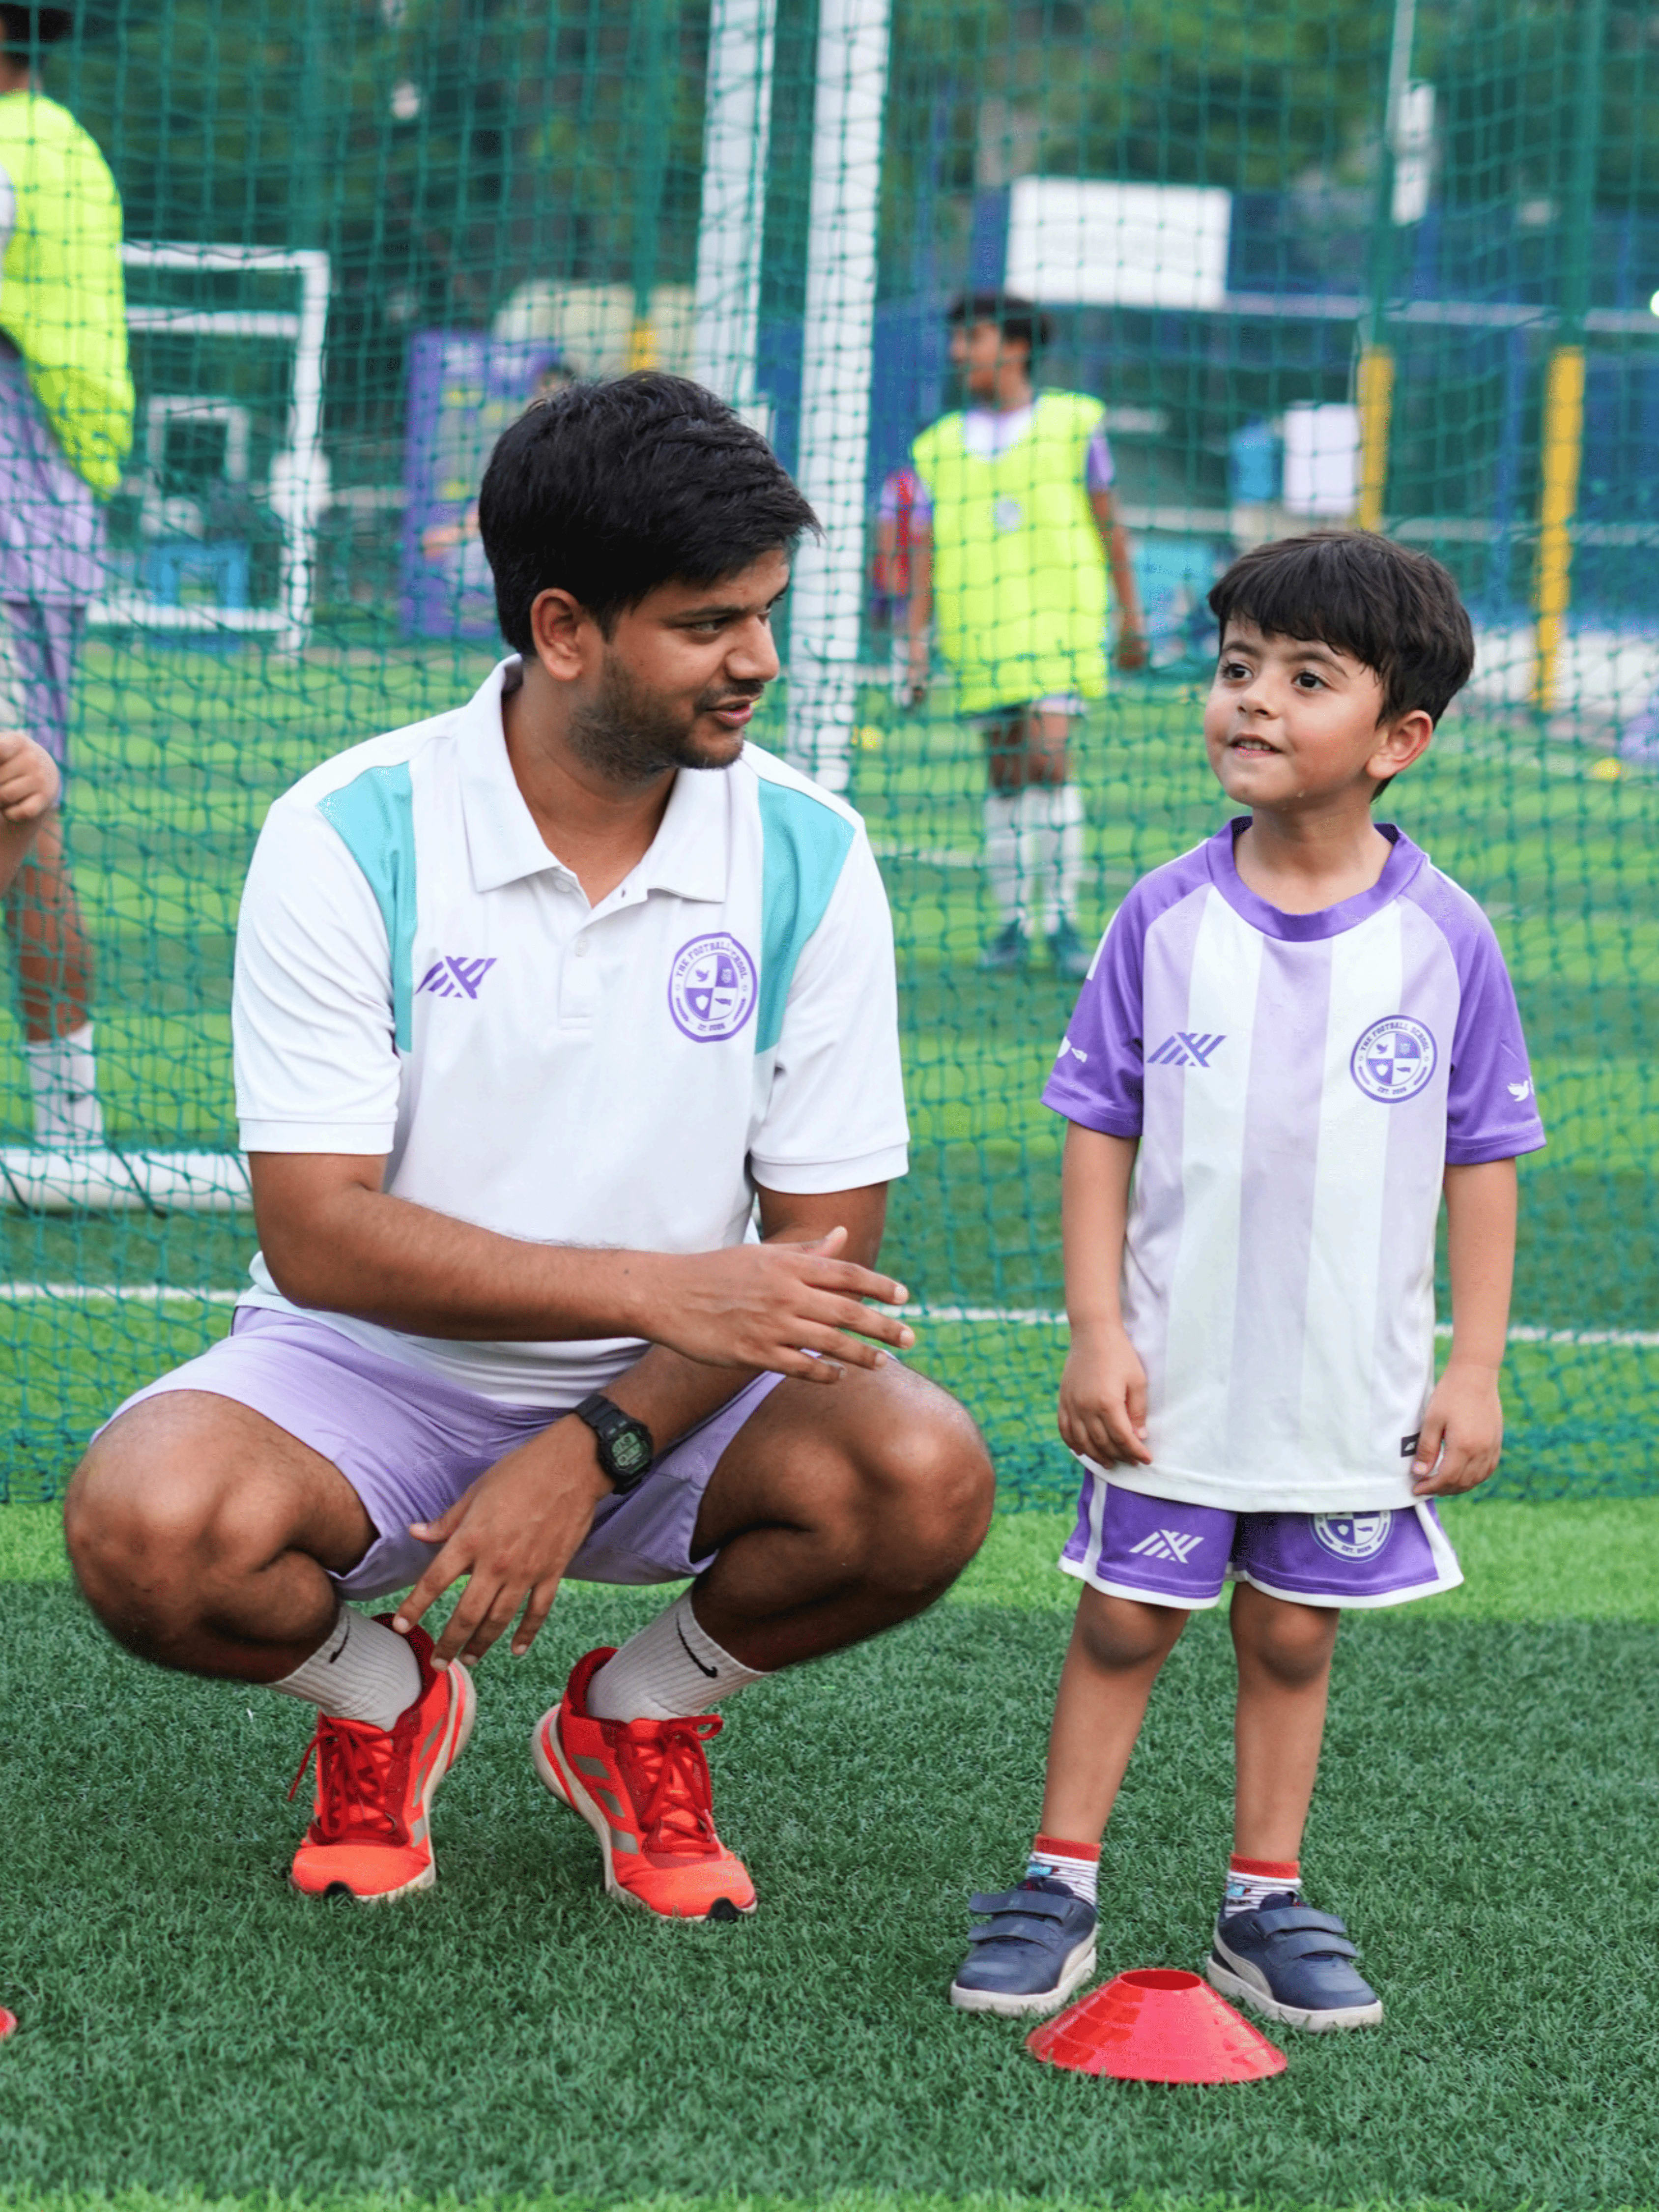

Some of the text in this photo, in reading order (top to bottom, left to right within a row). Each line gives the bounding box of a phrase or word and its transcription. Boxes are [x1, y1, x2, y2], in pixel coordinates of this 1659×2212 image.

[676, 959, 688, 977] THE
[1360, 1022, 1430, 1052] THE FOOTBALL SCHOOL
